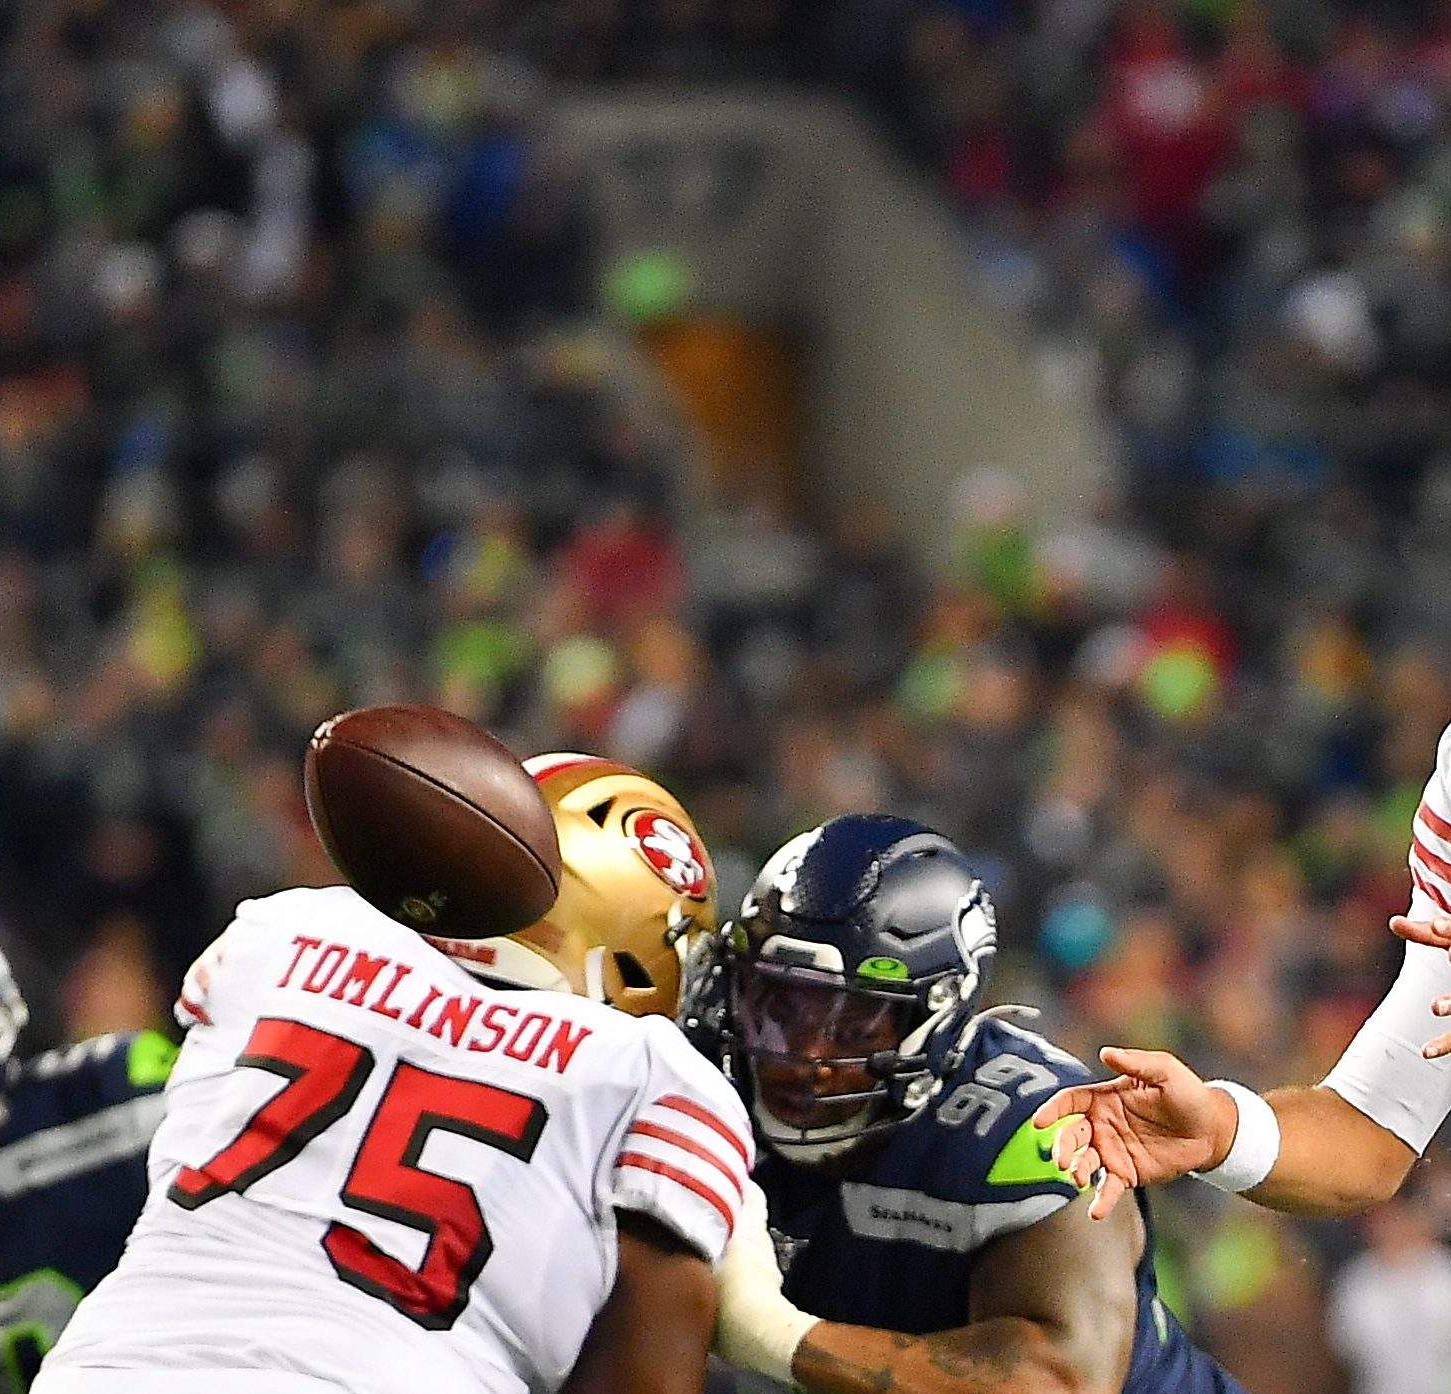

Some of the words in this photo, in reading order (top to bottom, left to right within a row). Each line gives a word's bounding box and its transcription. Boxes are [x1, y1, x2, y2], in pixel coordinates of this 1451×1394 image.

[276, 933, 593, 1074] TOMLINSON
[936, 1053, 1060, 1138] 99
[167, 1018, 547, 1330] 75
